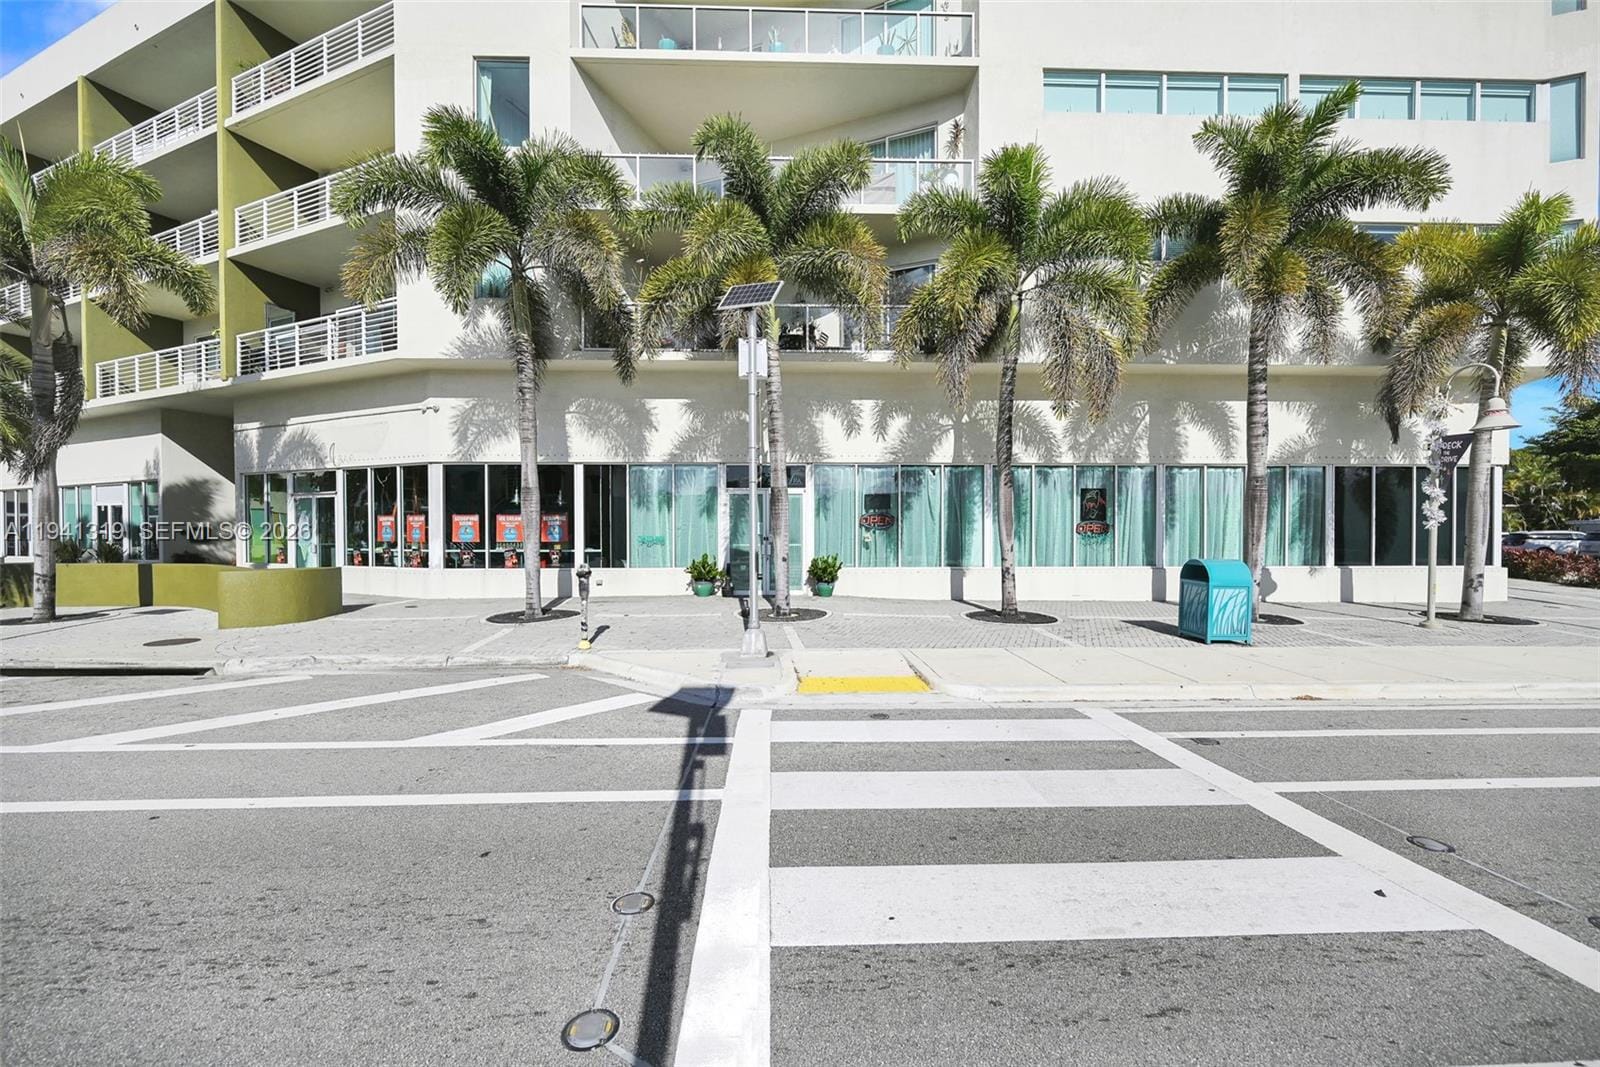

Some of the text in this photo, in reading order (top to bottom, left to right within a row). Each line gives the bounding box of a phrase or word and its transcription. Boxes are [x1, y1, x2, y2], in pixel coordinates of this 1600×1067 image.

[1442, 440, 1463, 450] DECK
[861, 515, 895, 526] OPEN
[1077, 523, 1109, 533] OPEN
